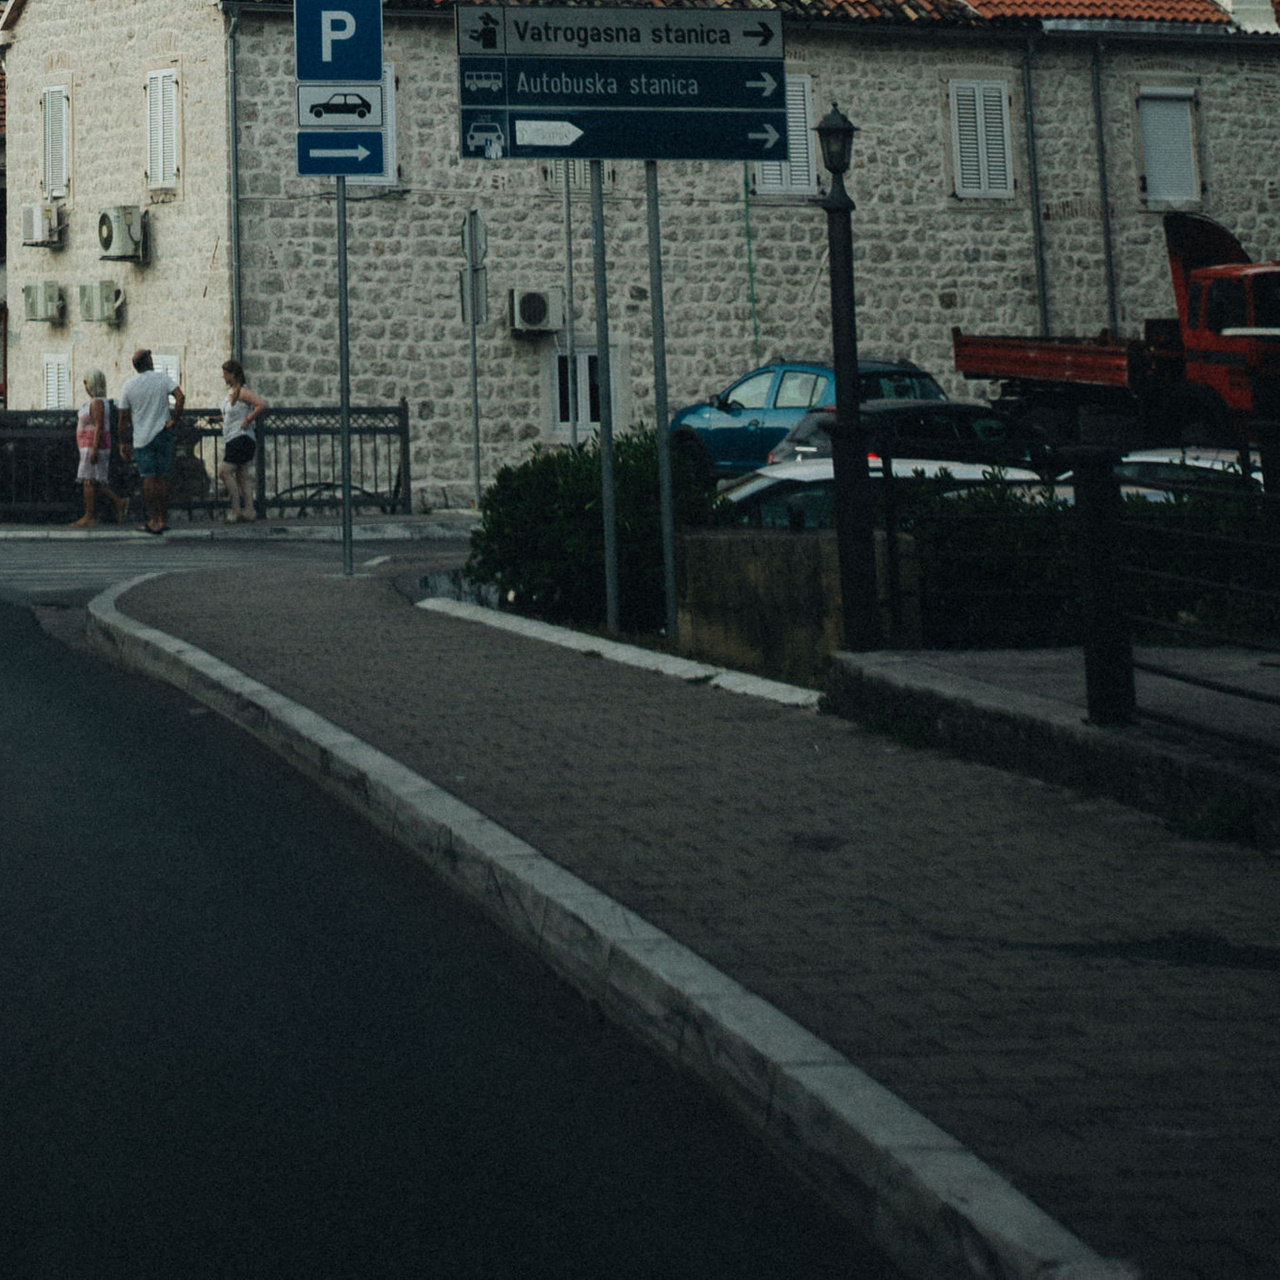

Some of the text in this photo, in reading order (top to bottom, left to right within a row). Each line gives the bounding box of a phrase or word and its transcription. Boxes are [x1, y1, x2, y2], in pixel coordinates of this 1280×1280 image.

[320, 10, 356, 62] P
[513, 19, 730, 47] Vatrogasna stanica
[516, 72, 699, 96] Autobuska stanica
